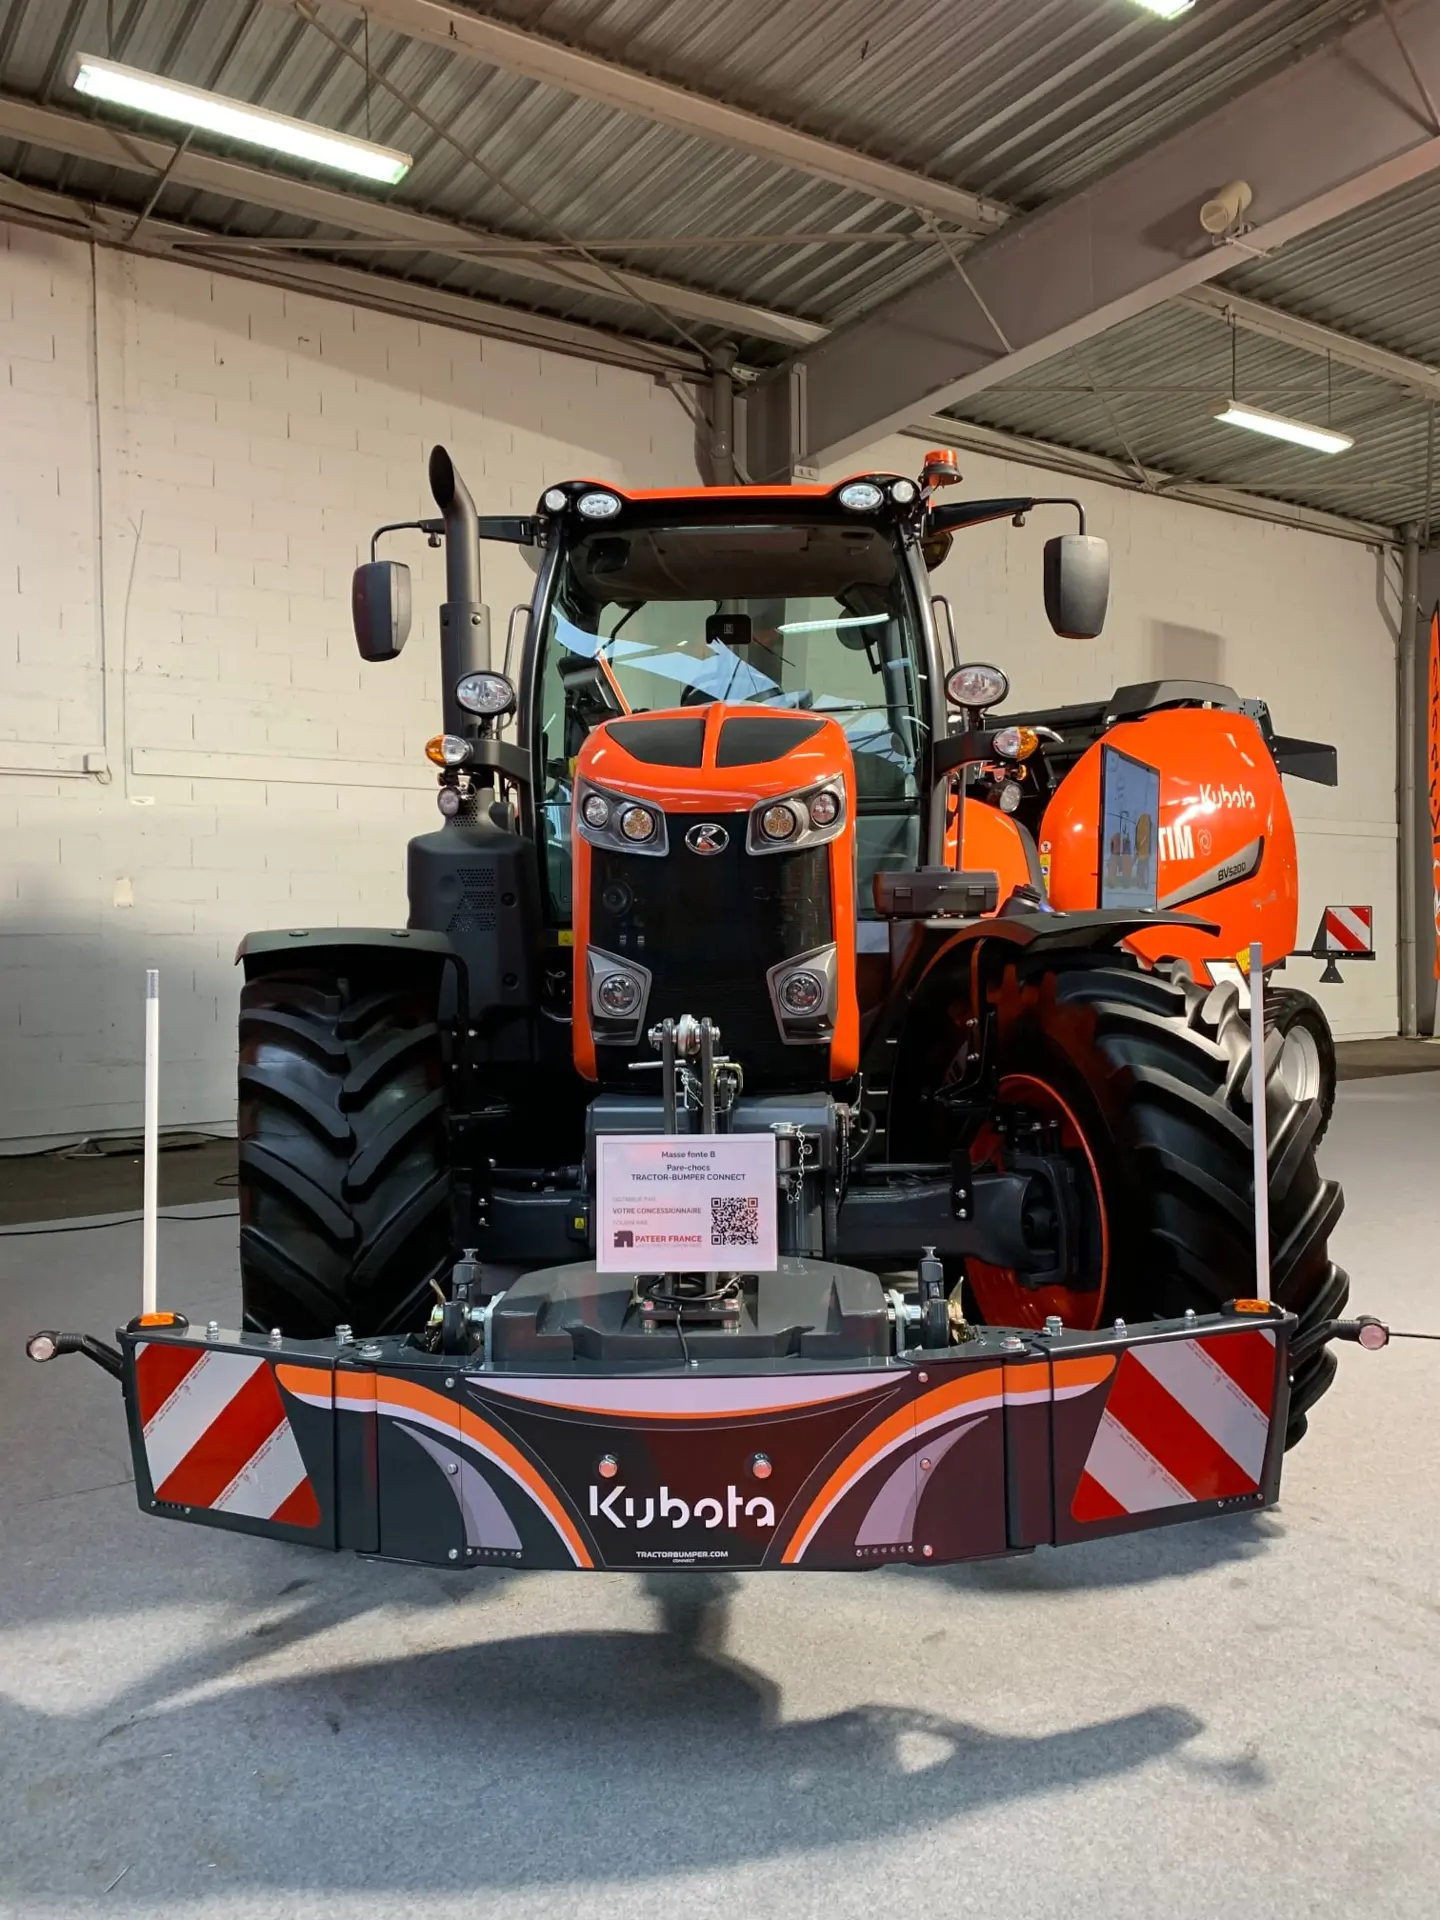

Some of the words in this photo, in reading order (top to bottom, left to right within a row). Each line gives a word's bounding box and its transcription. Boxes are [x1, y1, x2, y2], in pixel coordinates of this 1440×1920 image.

[1199, 783, 1256, 809] Kubota
[666, 1164, 711, 1172] Pare-chocs
[631, 1173, 705, 1181] TRACTOR-BUMPER
[707, 1173, 746, 1181] CONNECT
[612, 1207, 635, 1215] VOTRE
[636, 1207, 702, 1215] CONCESSIONNAIRE
[635, 1235, 667, 1243] PATEER
[668, 1235, 702, 1243] FRANCE
[589, 1485, 775, 1529] Kubota
[636, 1550, 729, 1558] TRACTORBUMPER.COM
